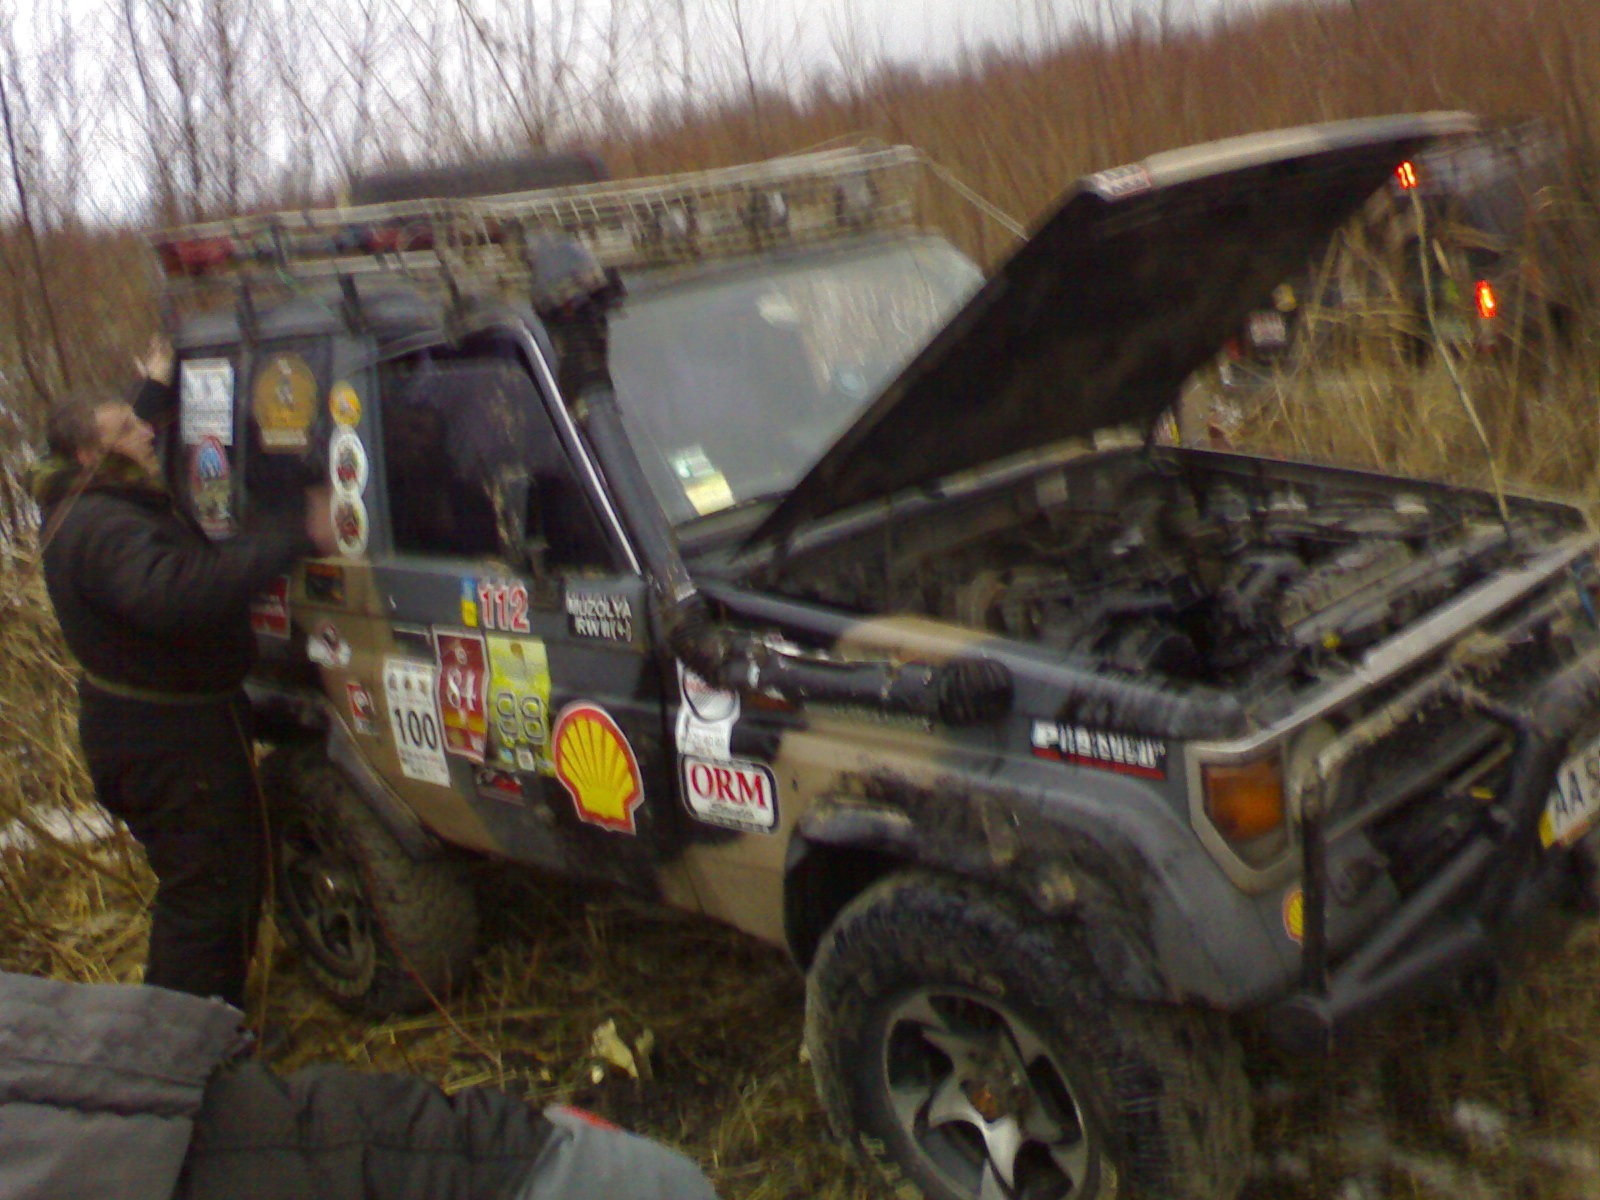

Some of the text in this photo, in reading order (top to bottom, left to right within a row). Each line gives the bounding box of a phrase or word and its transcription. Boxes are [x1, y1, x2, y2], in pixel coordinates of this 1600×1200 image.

[478, 582, 530, 633] 112
[394, 707, 438, 751] 100
[690, 762, 768, 810] ORM
